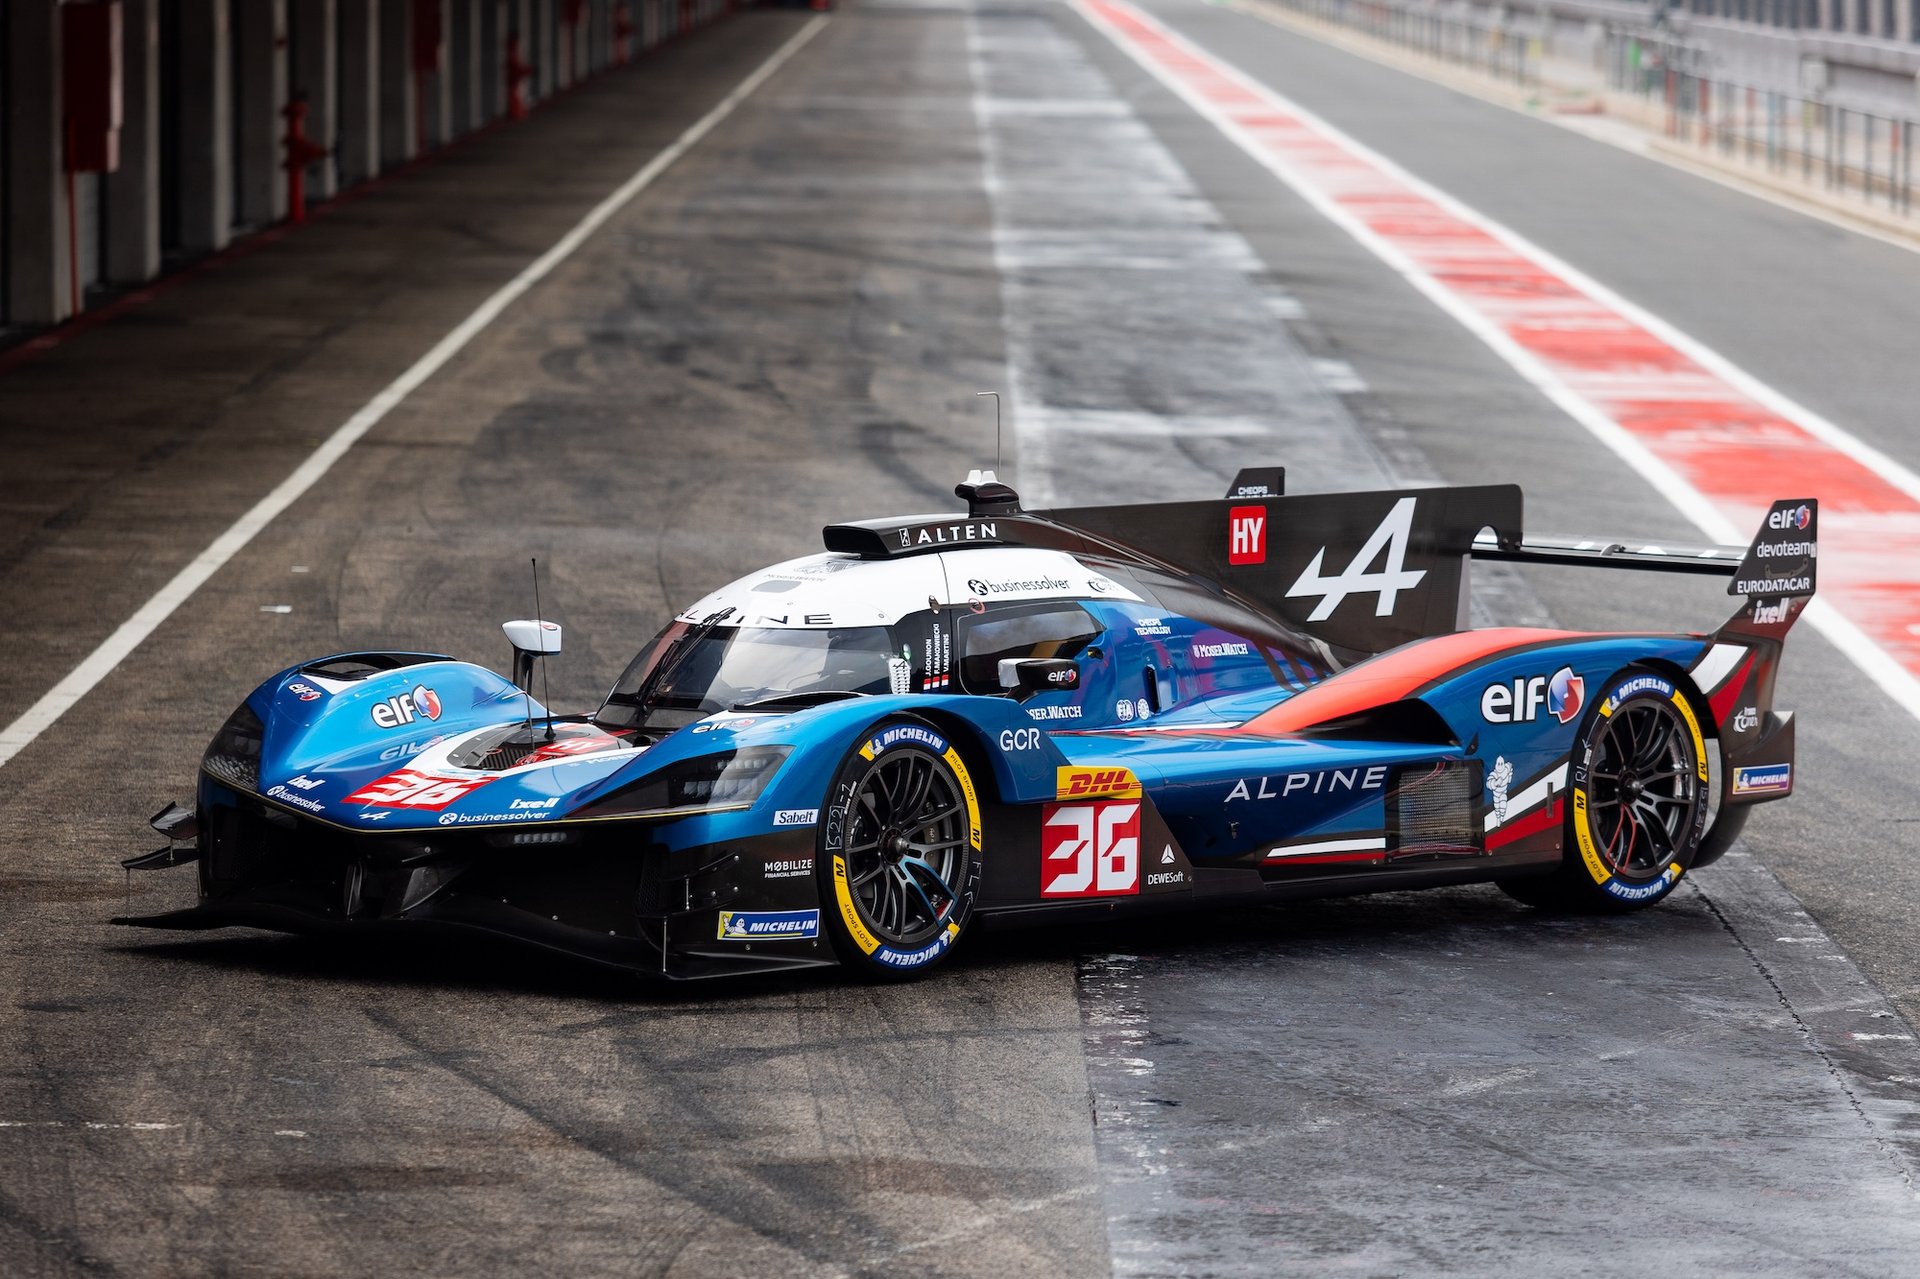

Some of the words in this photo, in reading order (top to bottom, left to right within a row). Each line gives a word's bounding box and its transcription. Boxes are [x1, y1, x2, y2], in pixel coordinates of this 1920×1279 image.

[1238, 486, 1268, 495] CHEOPS
[1768, 508, 1796, 529] elf
[917, 523, 997, 544] ALTEN
[1232, 517, 1264, 554] HY
[1756, 541, 1811, 558] devoteam
[987, 575, 1071, 594] businessolver
[1737, 577, 1810, 593] EURODATACAR
[680, 607, 833, 625] LINE
[1753, 597, 1790, 624] ixell
[1048, 670, 1067, 682] elf
[1618, 678, 1670, 700] MICHELIN
[1480, 676, 1546, 723] elf
[371, 693, 415, 728] elf
[1025, 706, 1083, 720] SER.WATCH
[883, 727, 943, 750] MICHELIN
[1000, 728, 1041, 751] GCR
[950, 754, 963, 774] PILOT
[962, 775, 975, 802] SPORT
[1068, 770, 1131, 795] DHL
[1224, 766, 1387, 803] ALPINE
[1750, 773, 1789, 785] MICHELIN
[509, 797, 561, 809] ixell
[1576, 795, 1585, 810] M
[458, 811, 550, 823] businessolver
[778, 811, 814, 824] Sabelt
[972, 828, 980, 844] M
[1043, 803, 1140, 893] 36
[764, 871, 790, 879] FINANCIAL
[790, 869, 811, 878] SERVICES
[835, 864, 845, 878] M
[1147, 871, 1184, 885] DEWESoft
[1608, 880, 1662, 899] MICHELIN
[749, 919, 817, 932] MICHELIN
[844, 904, 859, 929] SPORT
[857, 928, 872, 948] PILOT
[879, 941, 940, 966] MICHELIN
